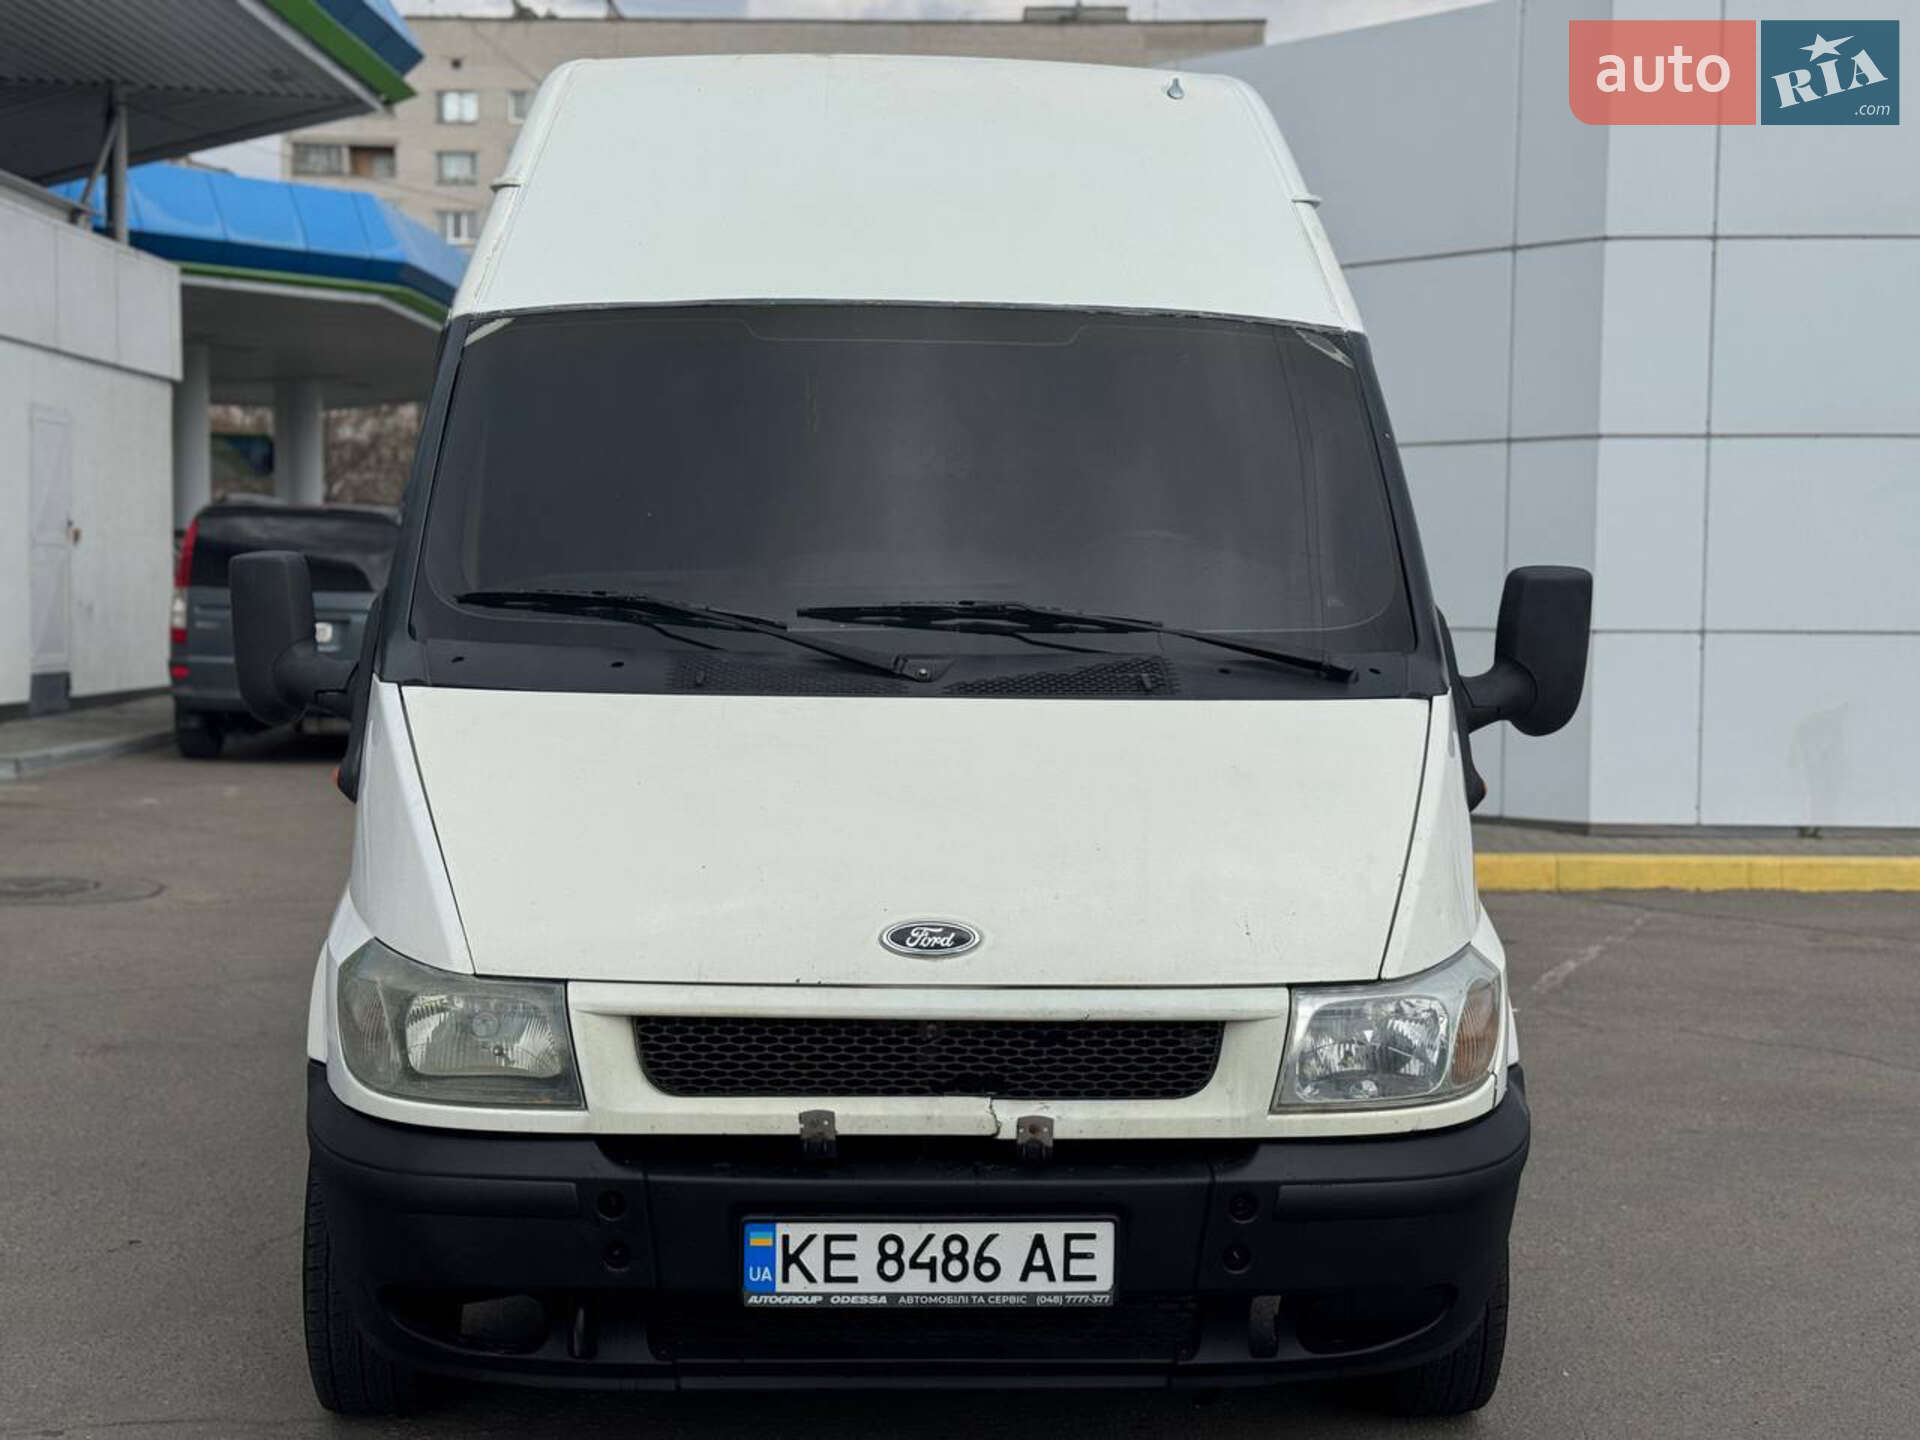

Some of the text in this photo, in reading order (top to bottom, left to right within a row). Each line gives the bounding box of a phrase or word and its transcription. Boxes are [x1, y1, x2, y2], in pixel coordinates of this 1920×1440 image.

[906, 926, 955, 948] Ford
[781, 1232, 1097, 1284] KE 8486 AE
[750, 1267, 772, 1281] UA
[748, 1295, 888, 1305] AUTOGROUP ODESSA
